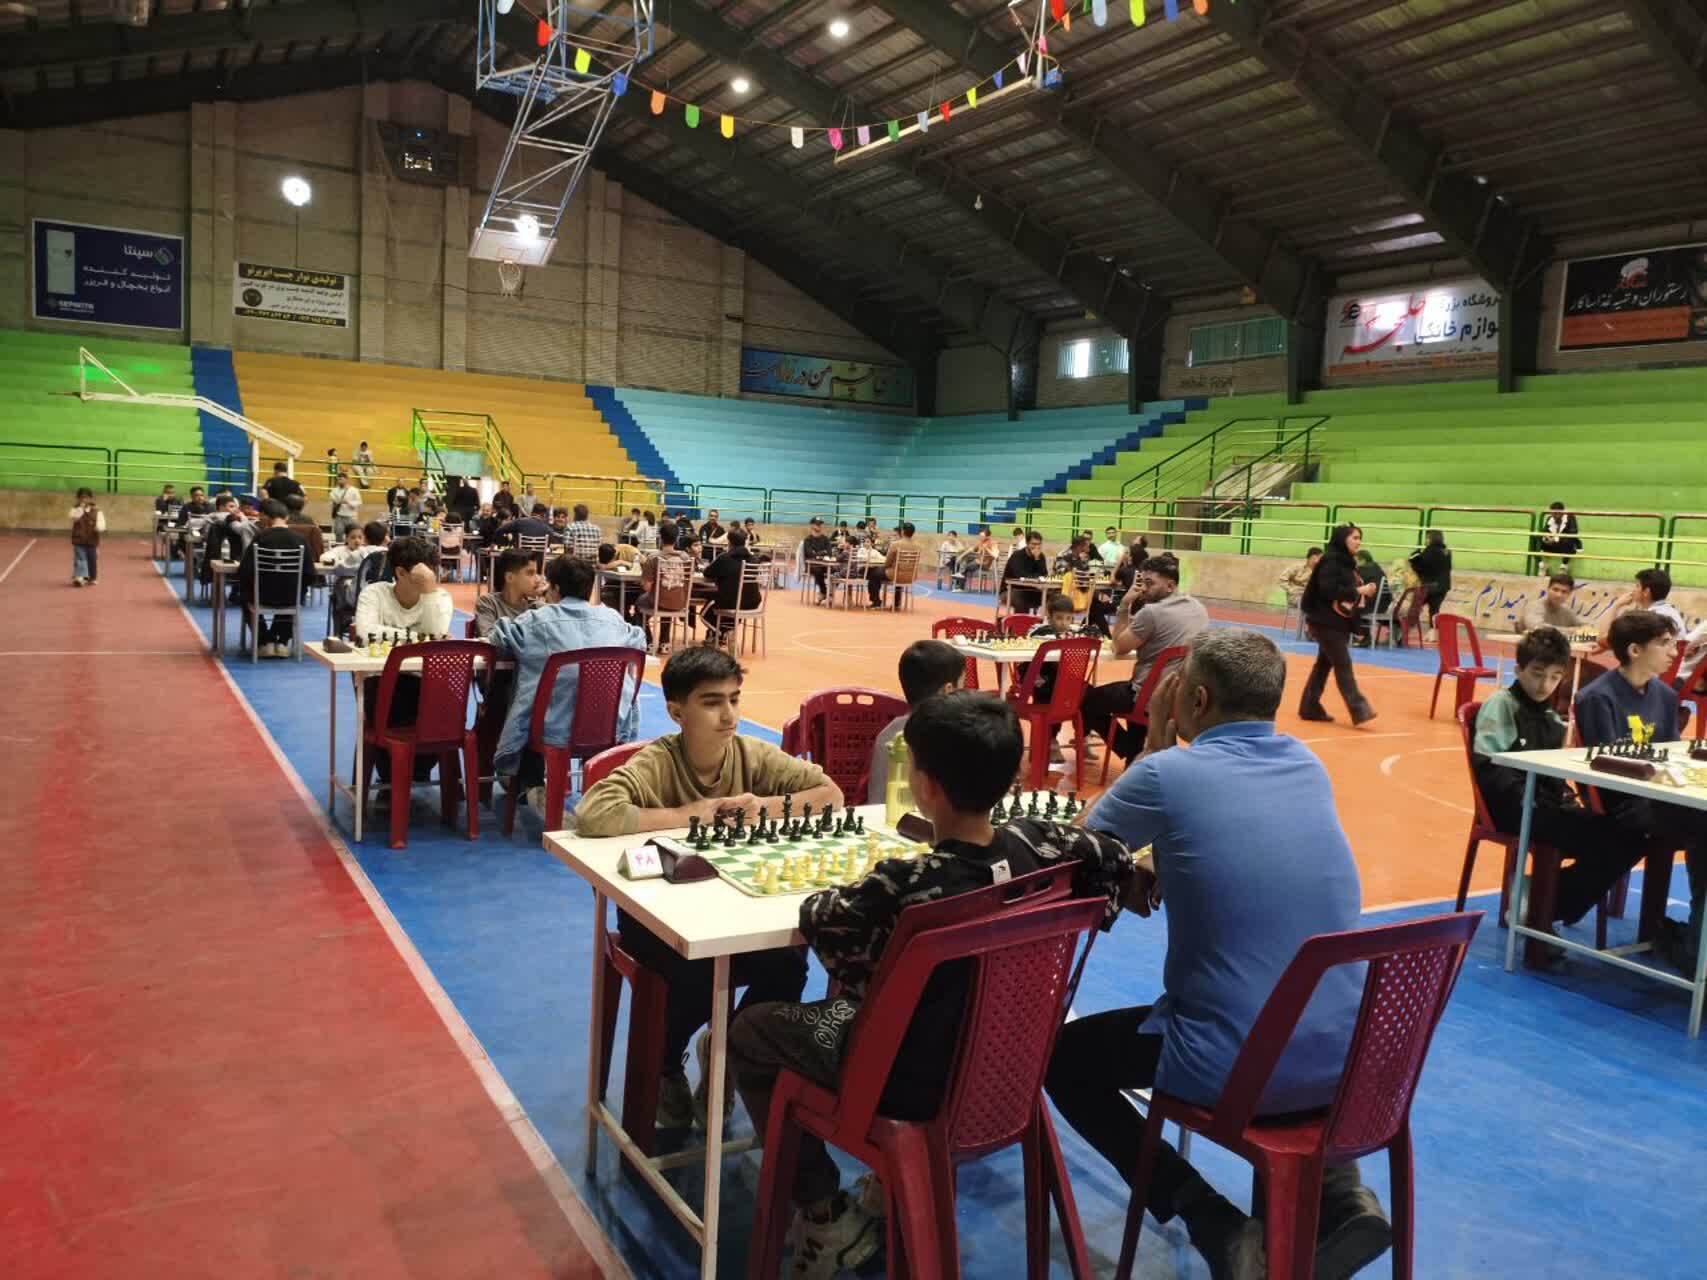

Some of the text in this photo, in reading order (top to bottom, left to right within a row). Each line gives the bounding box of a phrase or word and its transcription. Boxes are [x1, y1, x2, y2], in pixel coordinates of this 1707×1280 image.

[83, 278, 172, 295] انواع یخچال و فریزر
[1639, 282, 1688, 306] رستوران
[1461, 317, 1499, 341] وازم
